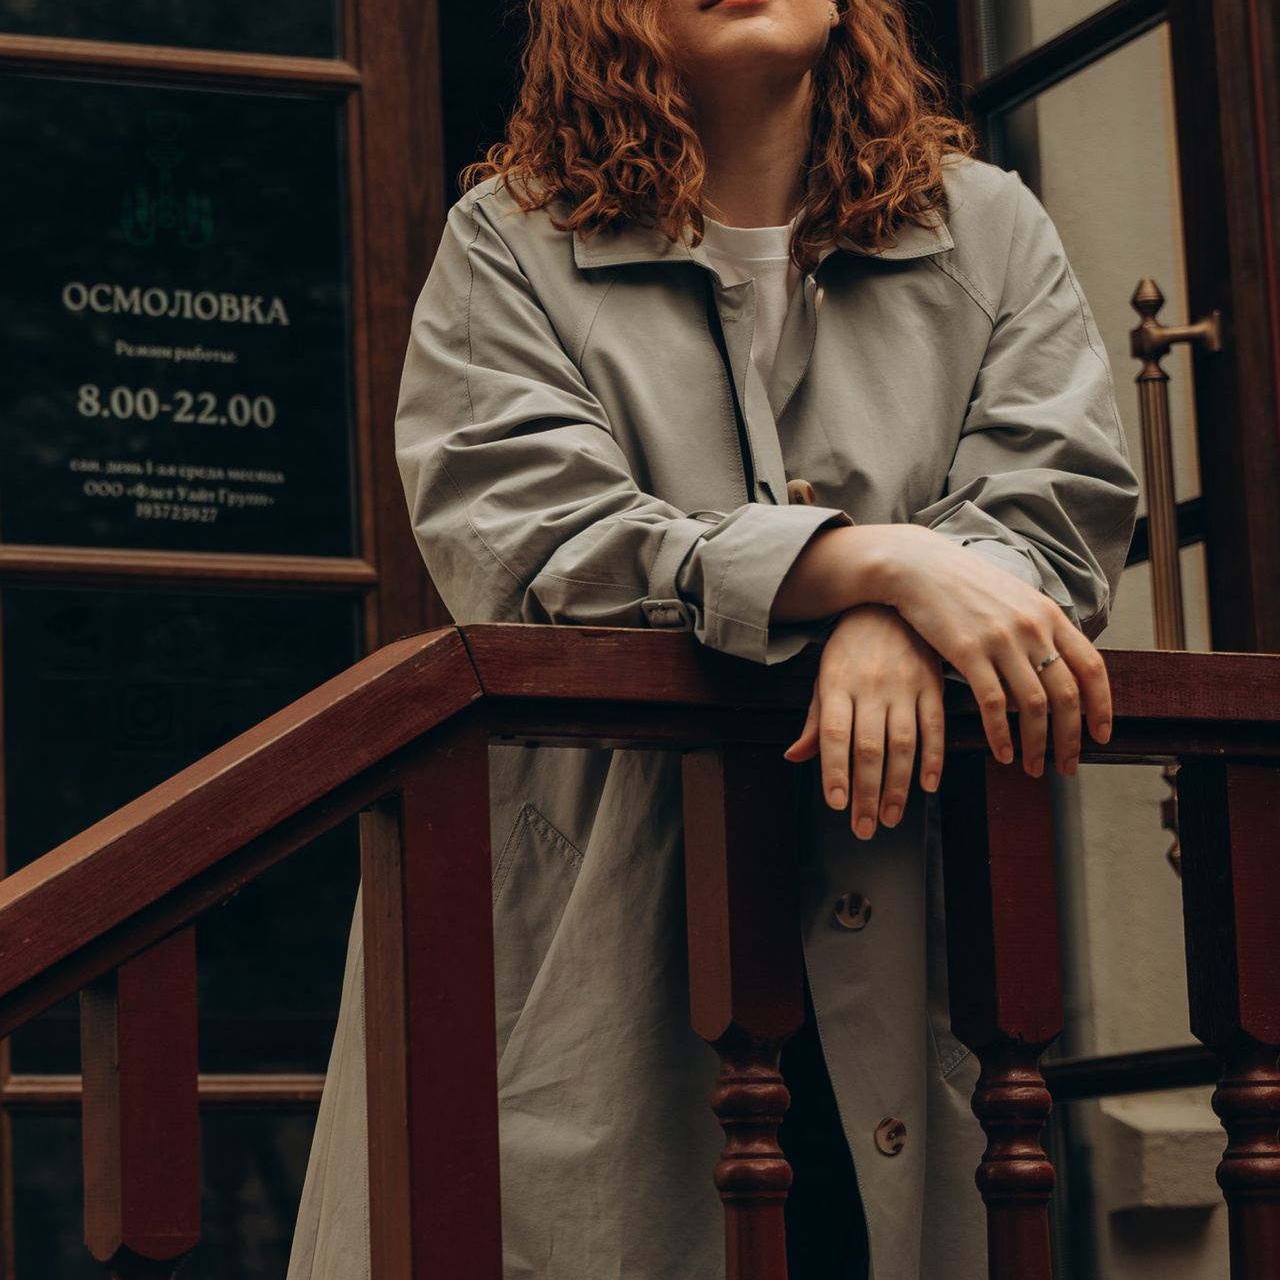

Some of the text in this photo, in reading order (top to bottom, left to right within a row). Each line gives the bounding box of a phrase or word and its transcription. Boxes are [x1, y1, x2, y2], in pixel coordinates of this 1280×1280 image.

[62, 282, 289, 325] ОСМОЛОВКА
[115, 339, 172, 359] Режим
[77, 383, 276, 428] 8.00-22.00
[105, 460, 144, 475] день
[179, 463, 224, 481] среда
[227, 467, 285, 484] месяца
[83, 479, 124, 497] ООО
[176, 485, 215, 503] Уайт
[136, 501, 218, 523] 193725927
